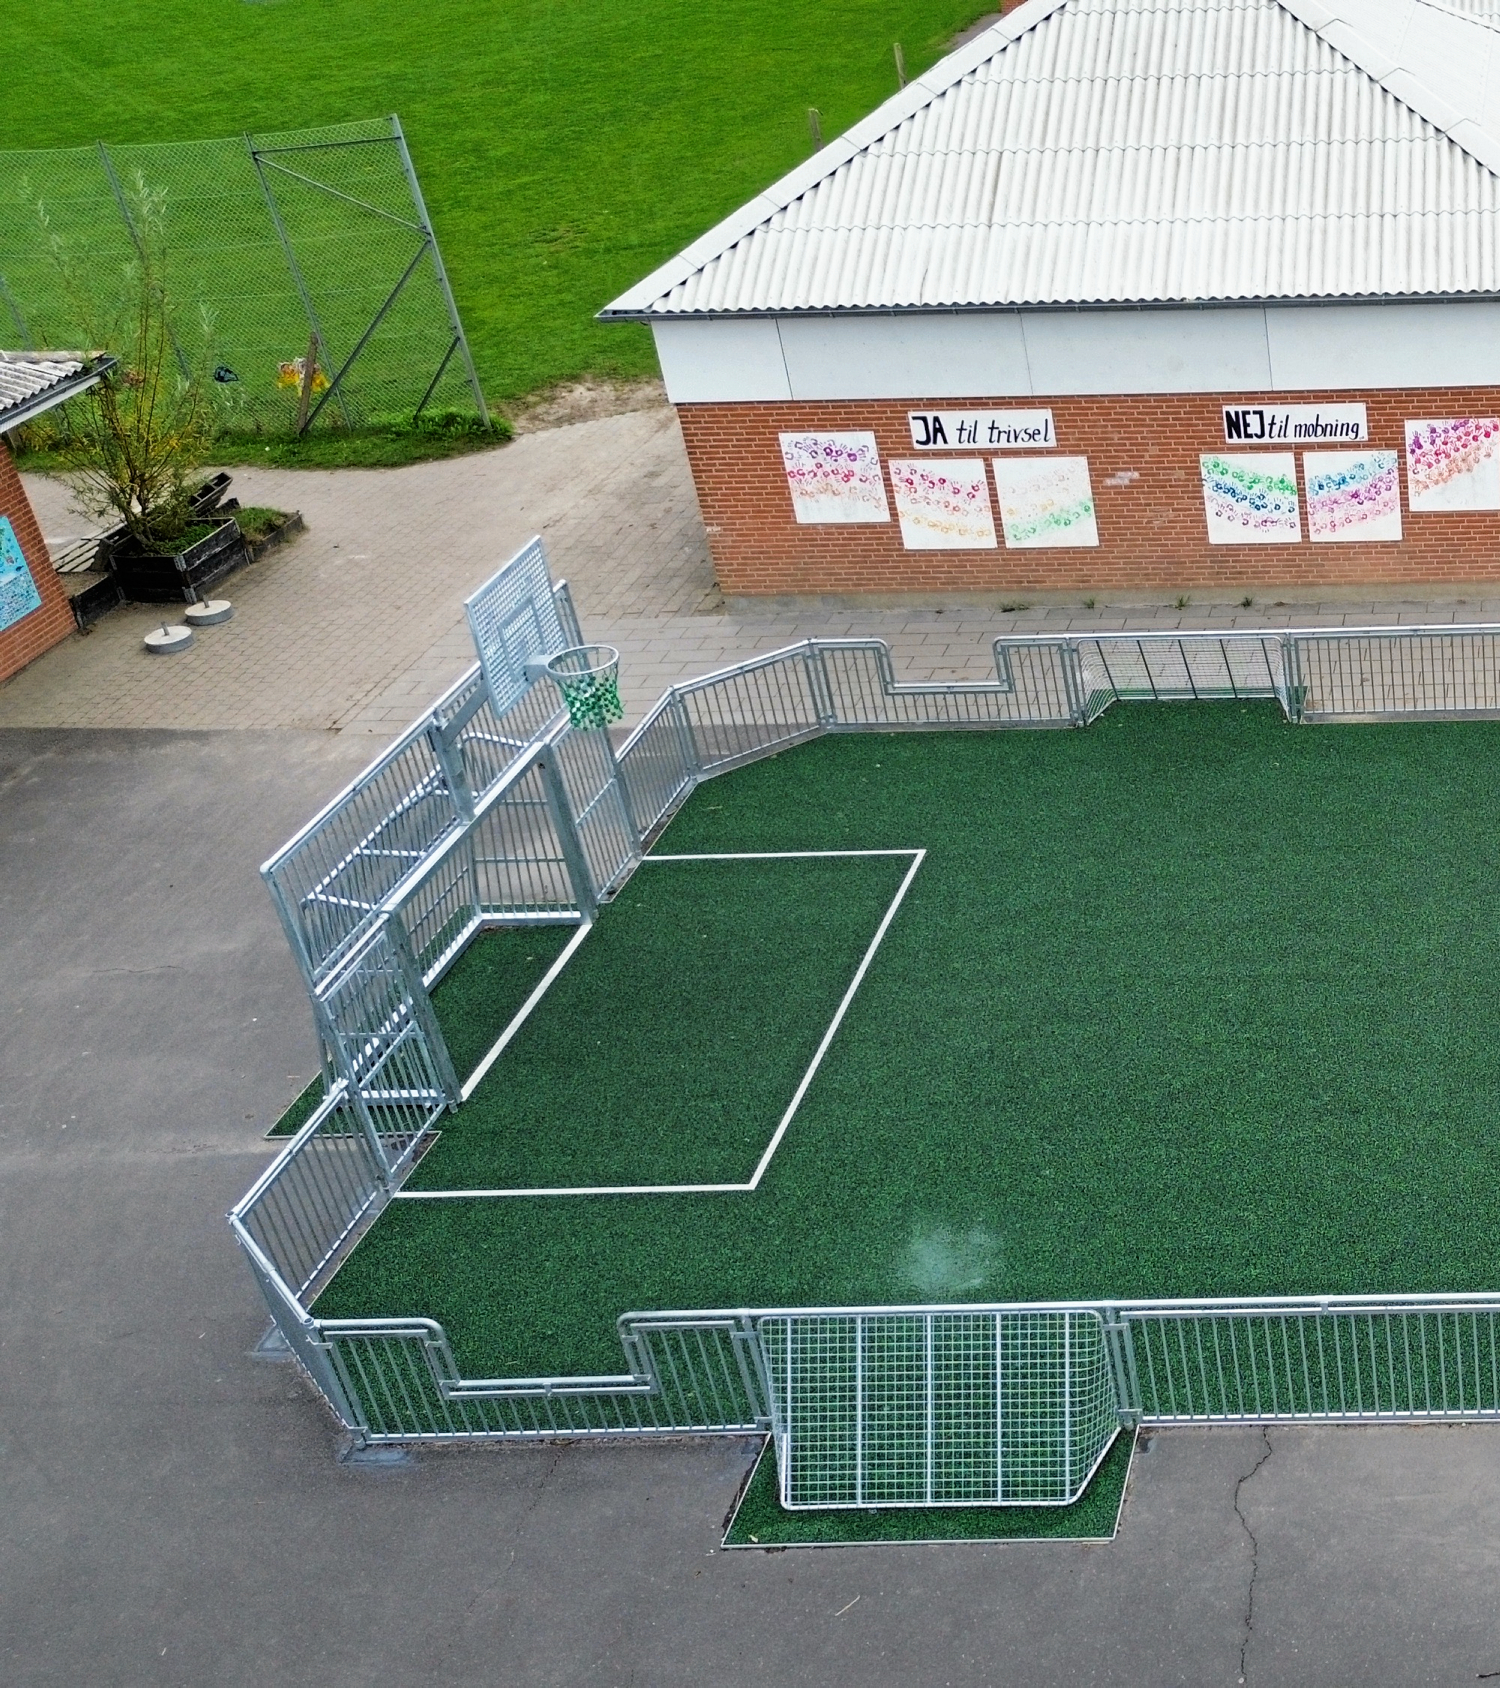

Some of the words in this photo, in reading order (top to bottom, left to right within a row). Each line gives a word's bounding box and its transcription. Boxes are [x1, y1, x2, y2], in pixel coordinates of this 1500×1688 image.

[911, 415, 949, 446] JA
[956, 419, 978, 444] til
[988, 418, 1051, 444] trivsel
[1225, 410, 1266, 439] NEJ
[1268, 414, 1289, 439] til
[1294, 413, 1360, 440] mobning
